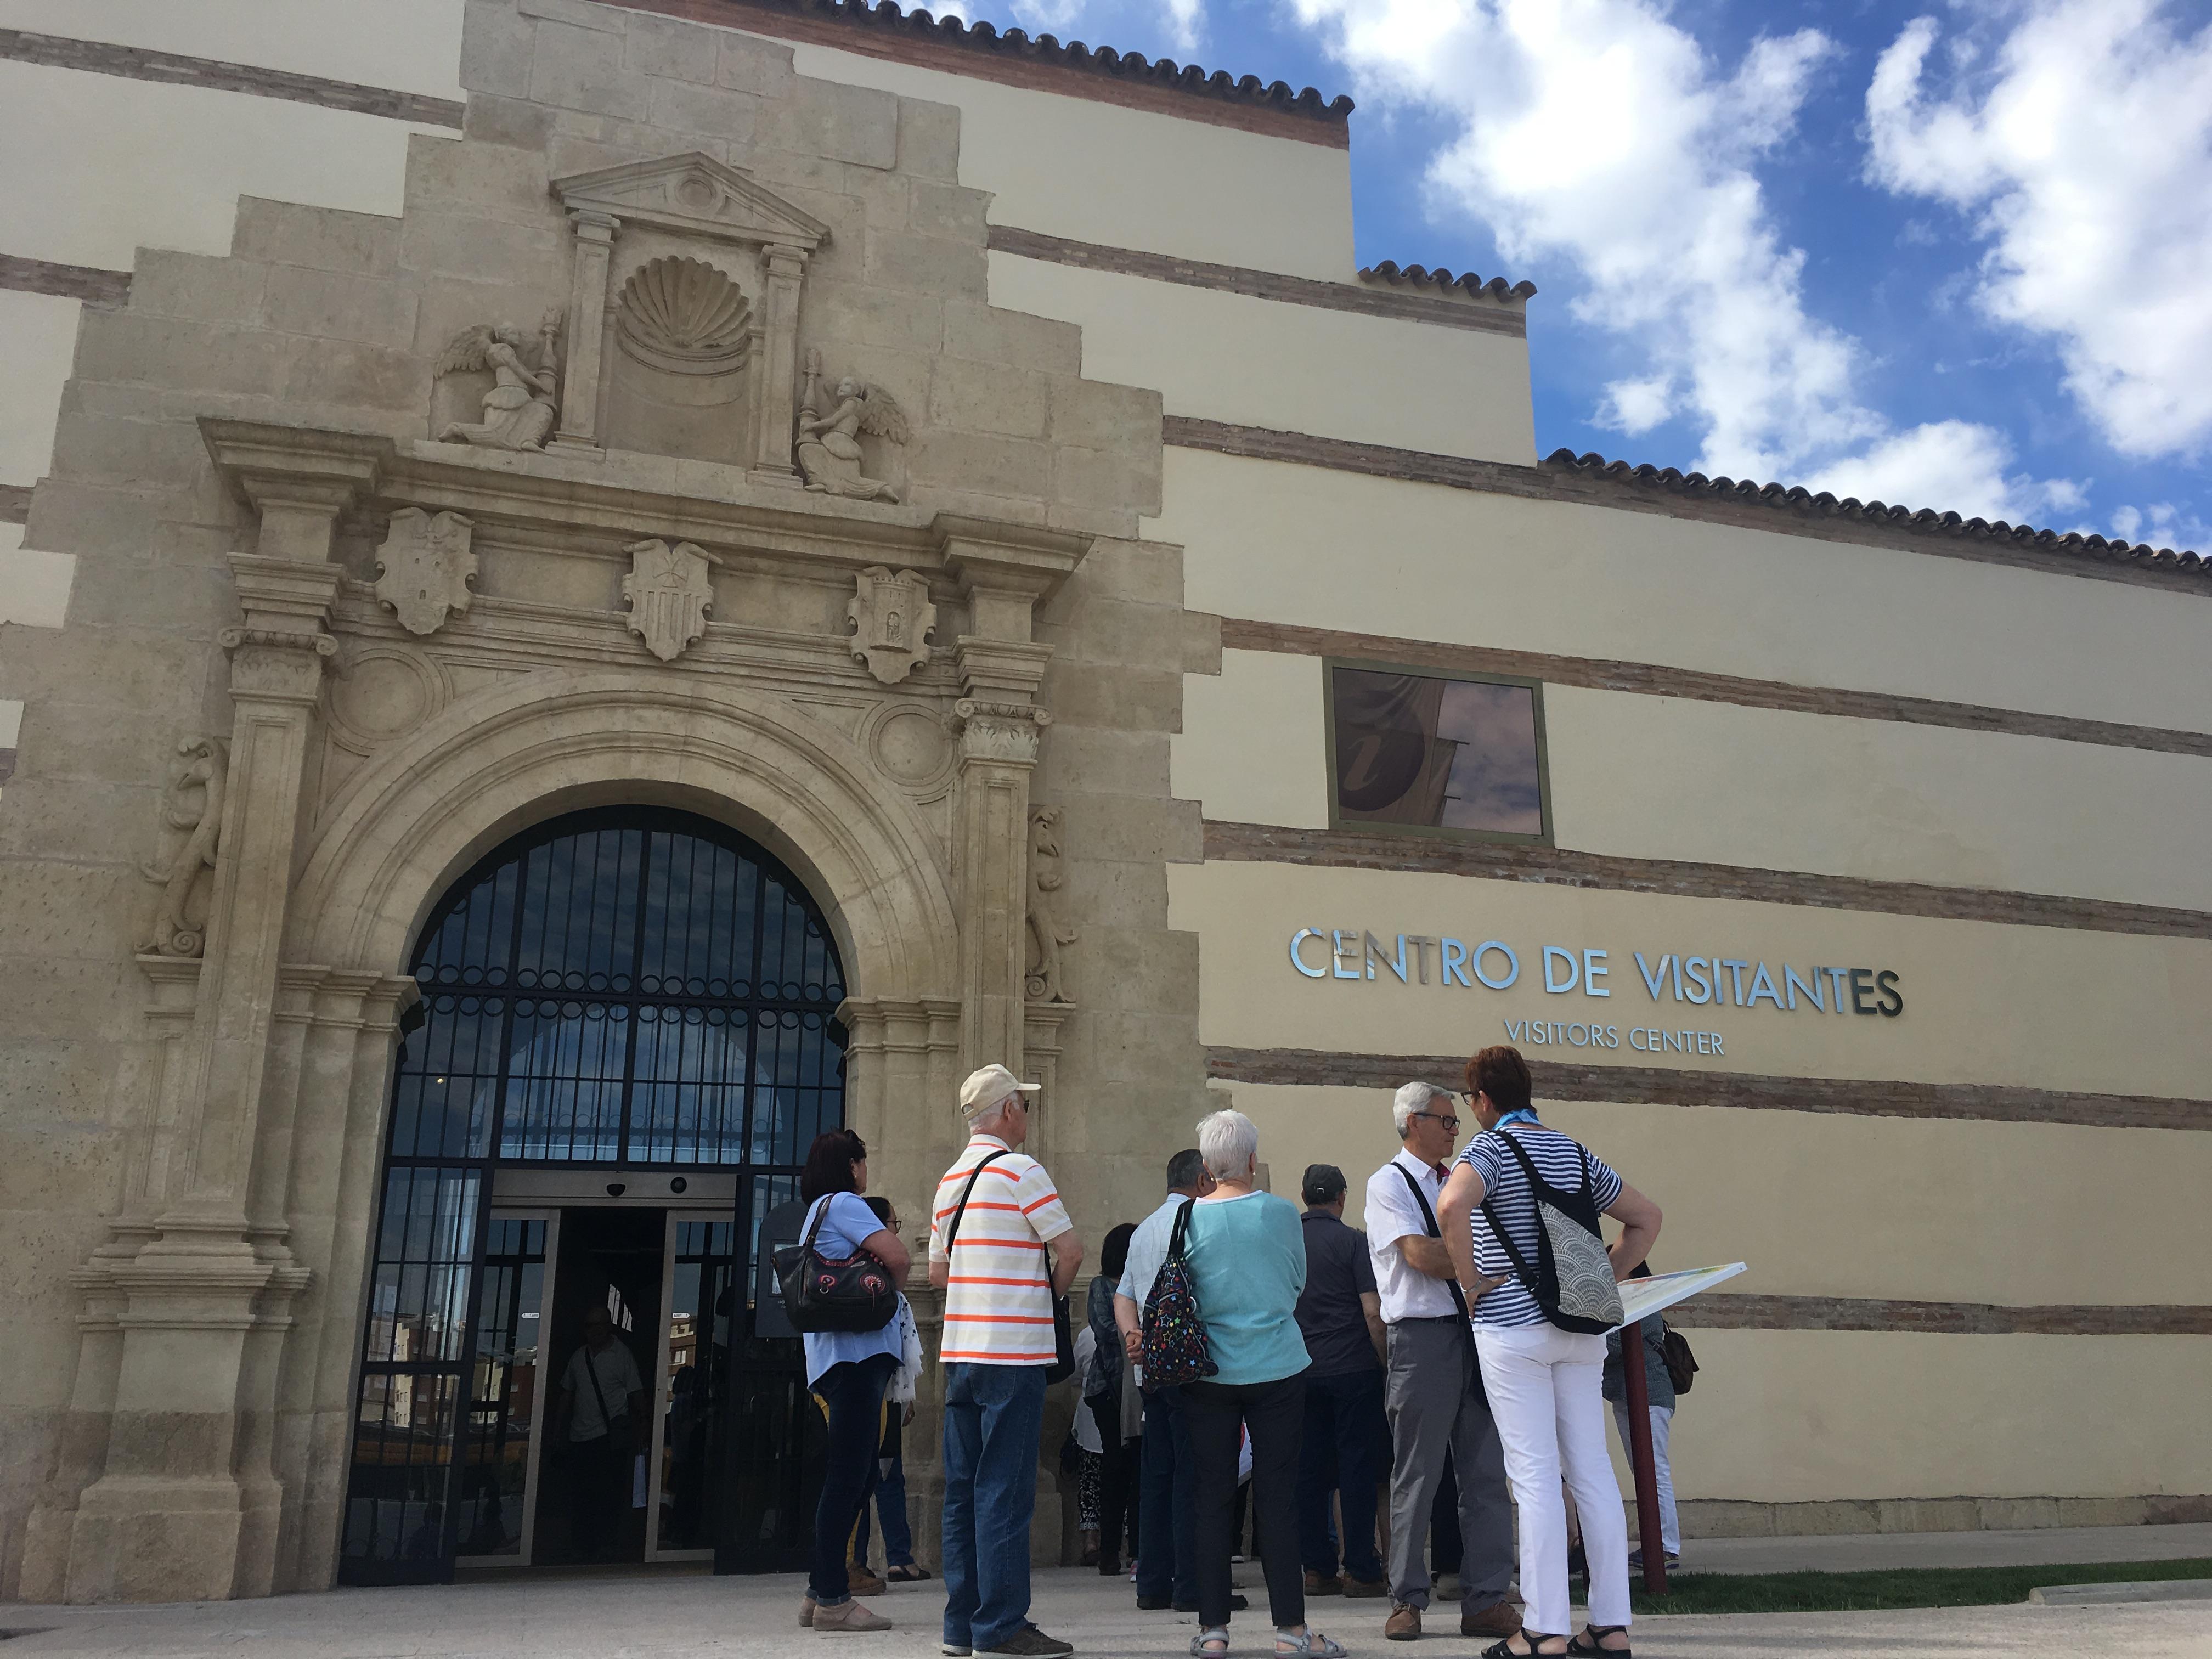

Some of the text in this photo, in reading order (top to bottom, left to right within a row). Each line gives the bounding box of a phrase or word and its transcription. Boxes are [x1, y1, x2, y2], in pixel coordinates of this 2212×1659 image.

[1290, 927, 1903, 1017] CENTRO DE VISITANTES
[1504, 1018, 1725, 1055] VISITORS CENTER
